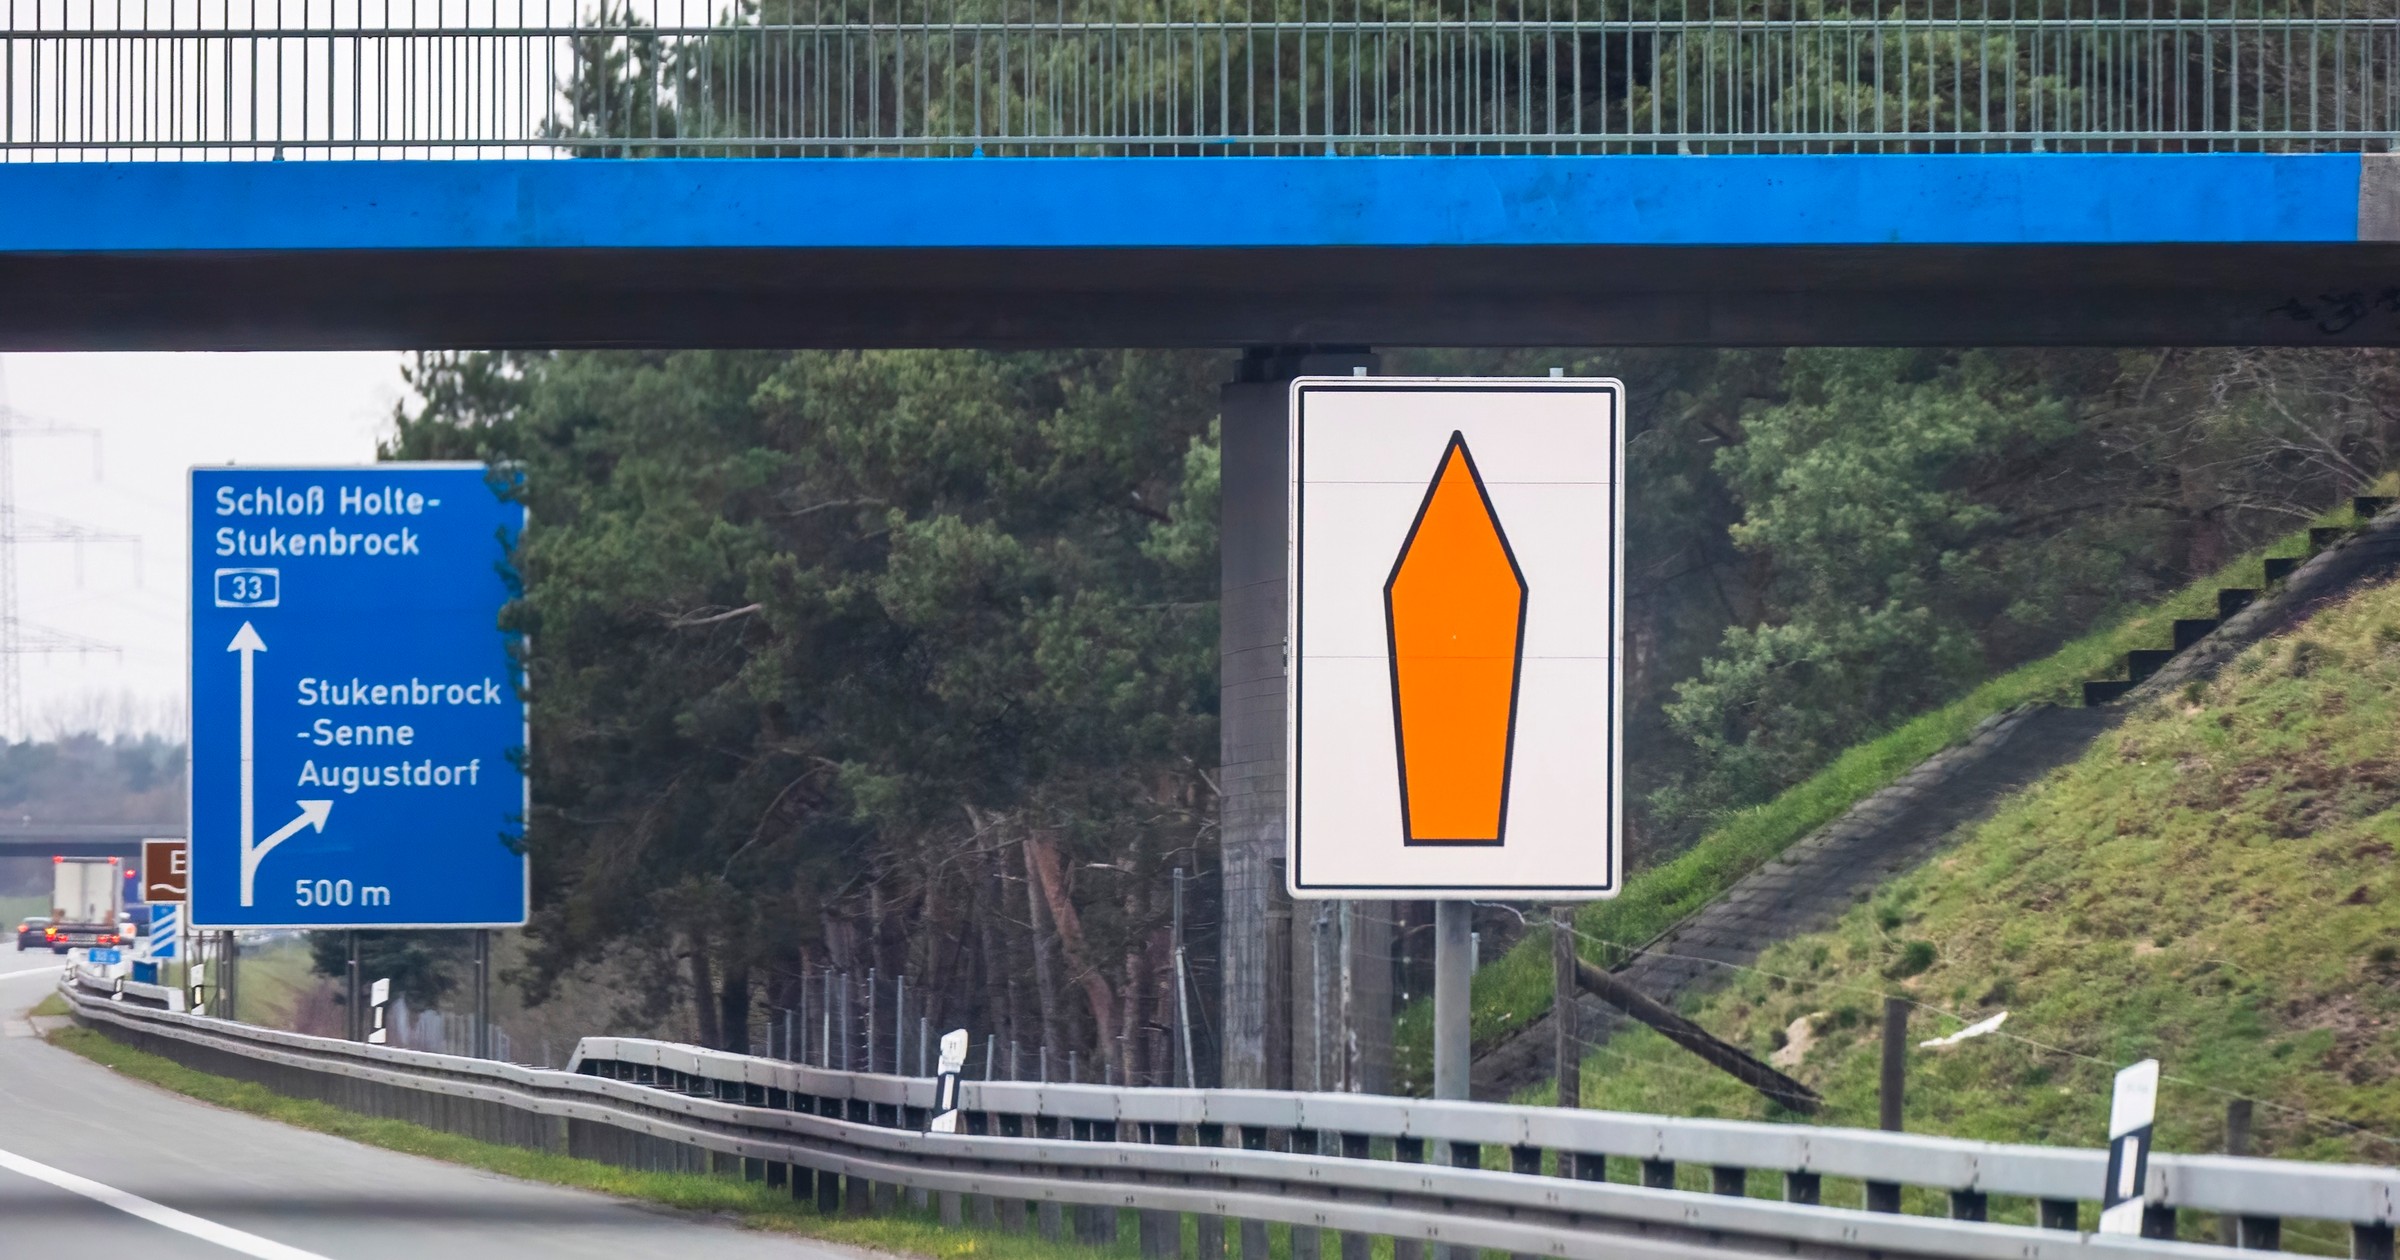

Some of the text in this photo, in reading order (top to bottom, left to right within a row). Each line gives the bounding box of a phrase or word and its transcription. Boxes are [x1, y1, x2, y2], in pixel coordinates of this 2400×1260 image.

[216, 486, 441, 516] Schloß Holte-
[216, 527, 419, 556] Stukenbrock
[232, 576, 263, 600] 33
[297, 677, 501, 706] Stukenbrock
[297, 718, 414, 746] -Senne
[297, 758, 480, 794] Augustdorf
[296, 879, 391, 907] 500 m
